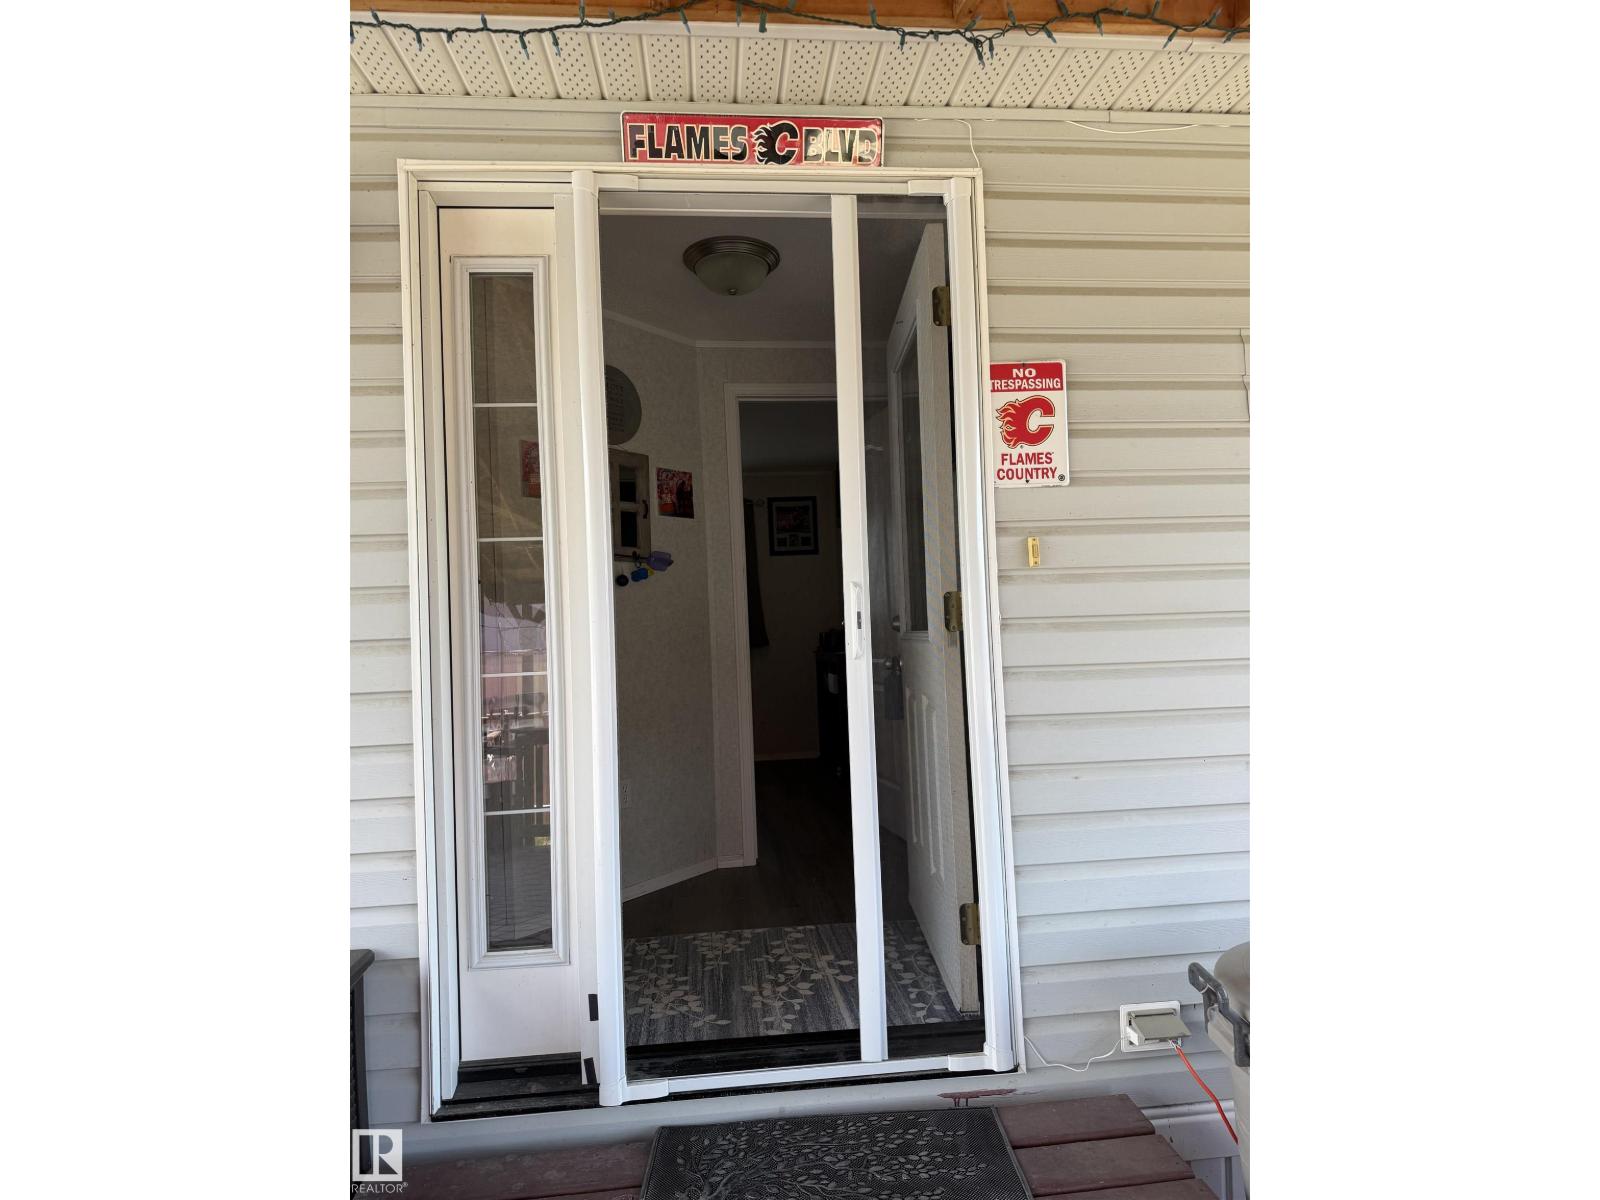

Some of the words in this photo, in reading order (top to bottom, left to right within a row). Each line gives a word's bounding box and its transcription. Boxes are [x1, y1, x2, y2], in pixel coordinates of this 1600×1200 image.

[626, 122, 749, 161] FLAMES
[802, 126, 879, 164] BLVD
[1012, 368, 1037, 378] NO
[1001, 452, 1053, 466] FLAMES
[996, 467, 1058, 481] COUNTRY
